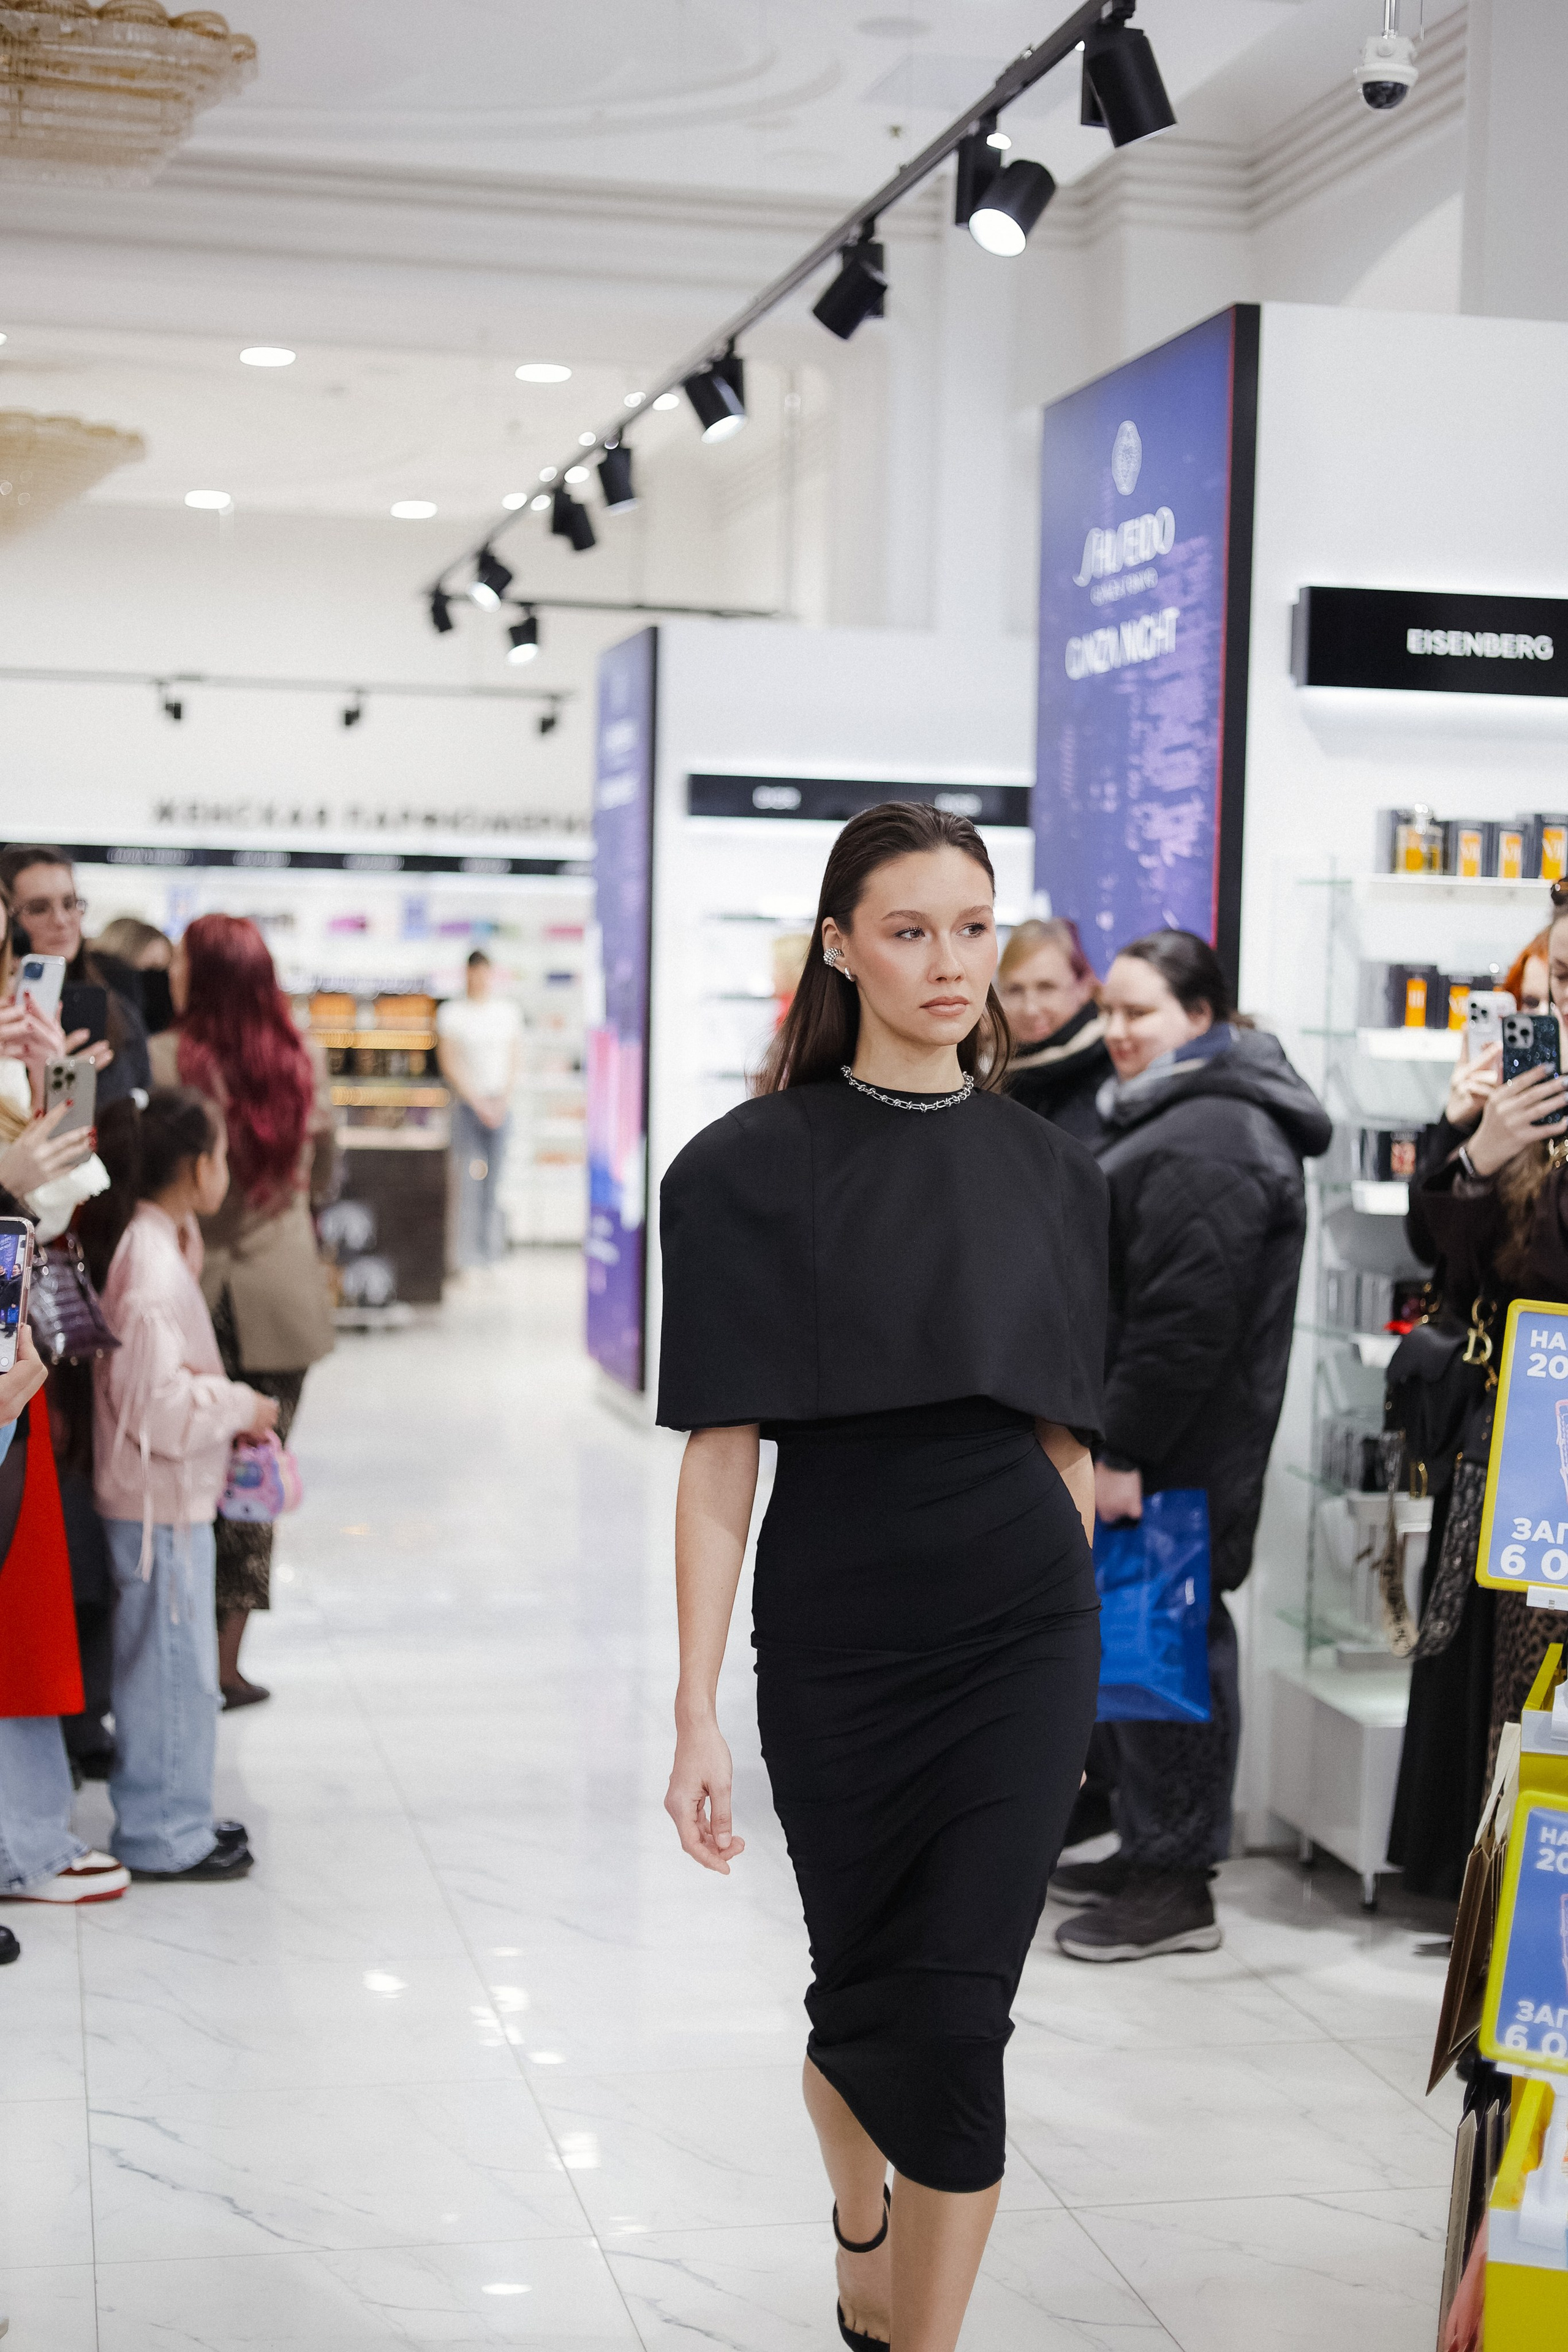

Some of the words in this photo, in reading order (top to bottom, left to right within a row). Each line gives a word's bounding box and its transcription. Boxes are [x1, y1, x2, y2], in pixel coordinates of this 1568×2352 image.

[1407, 628, 1554, 660] EISENBERG
[1500, 1544, 1526, 1576] 6
[1504, 2024, 1529, 2051] 6
